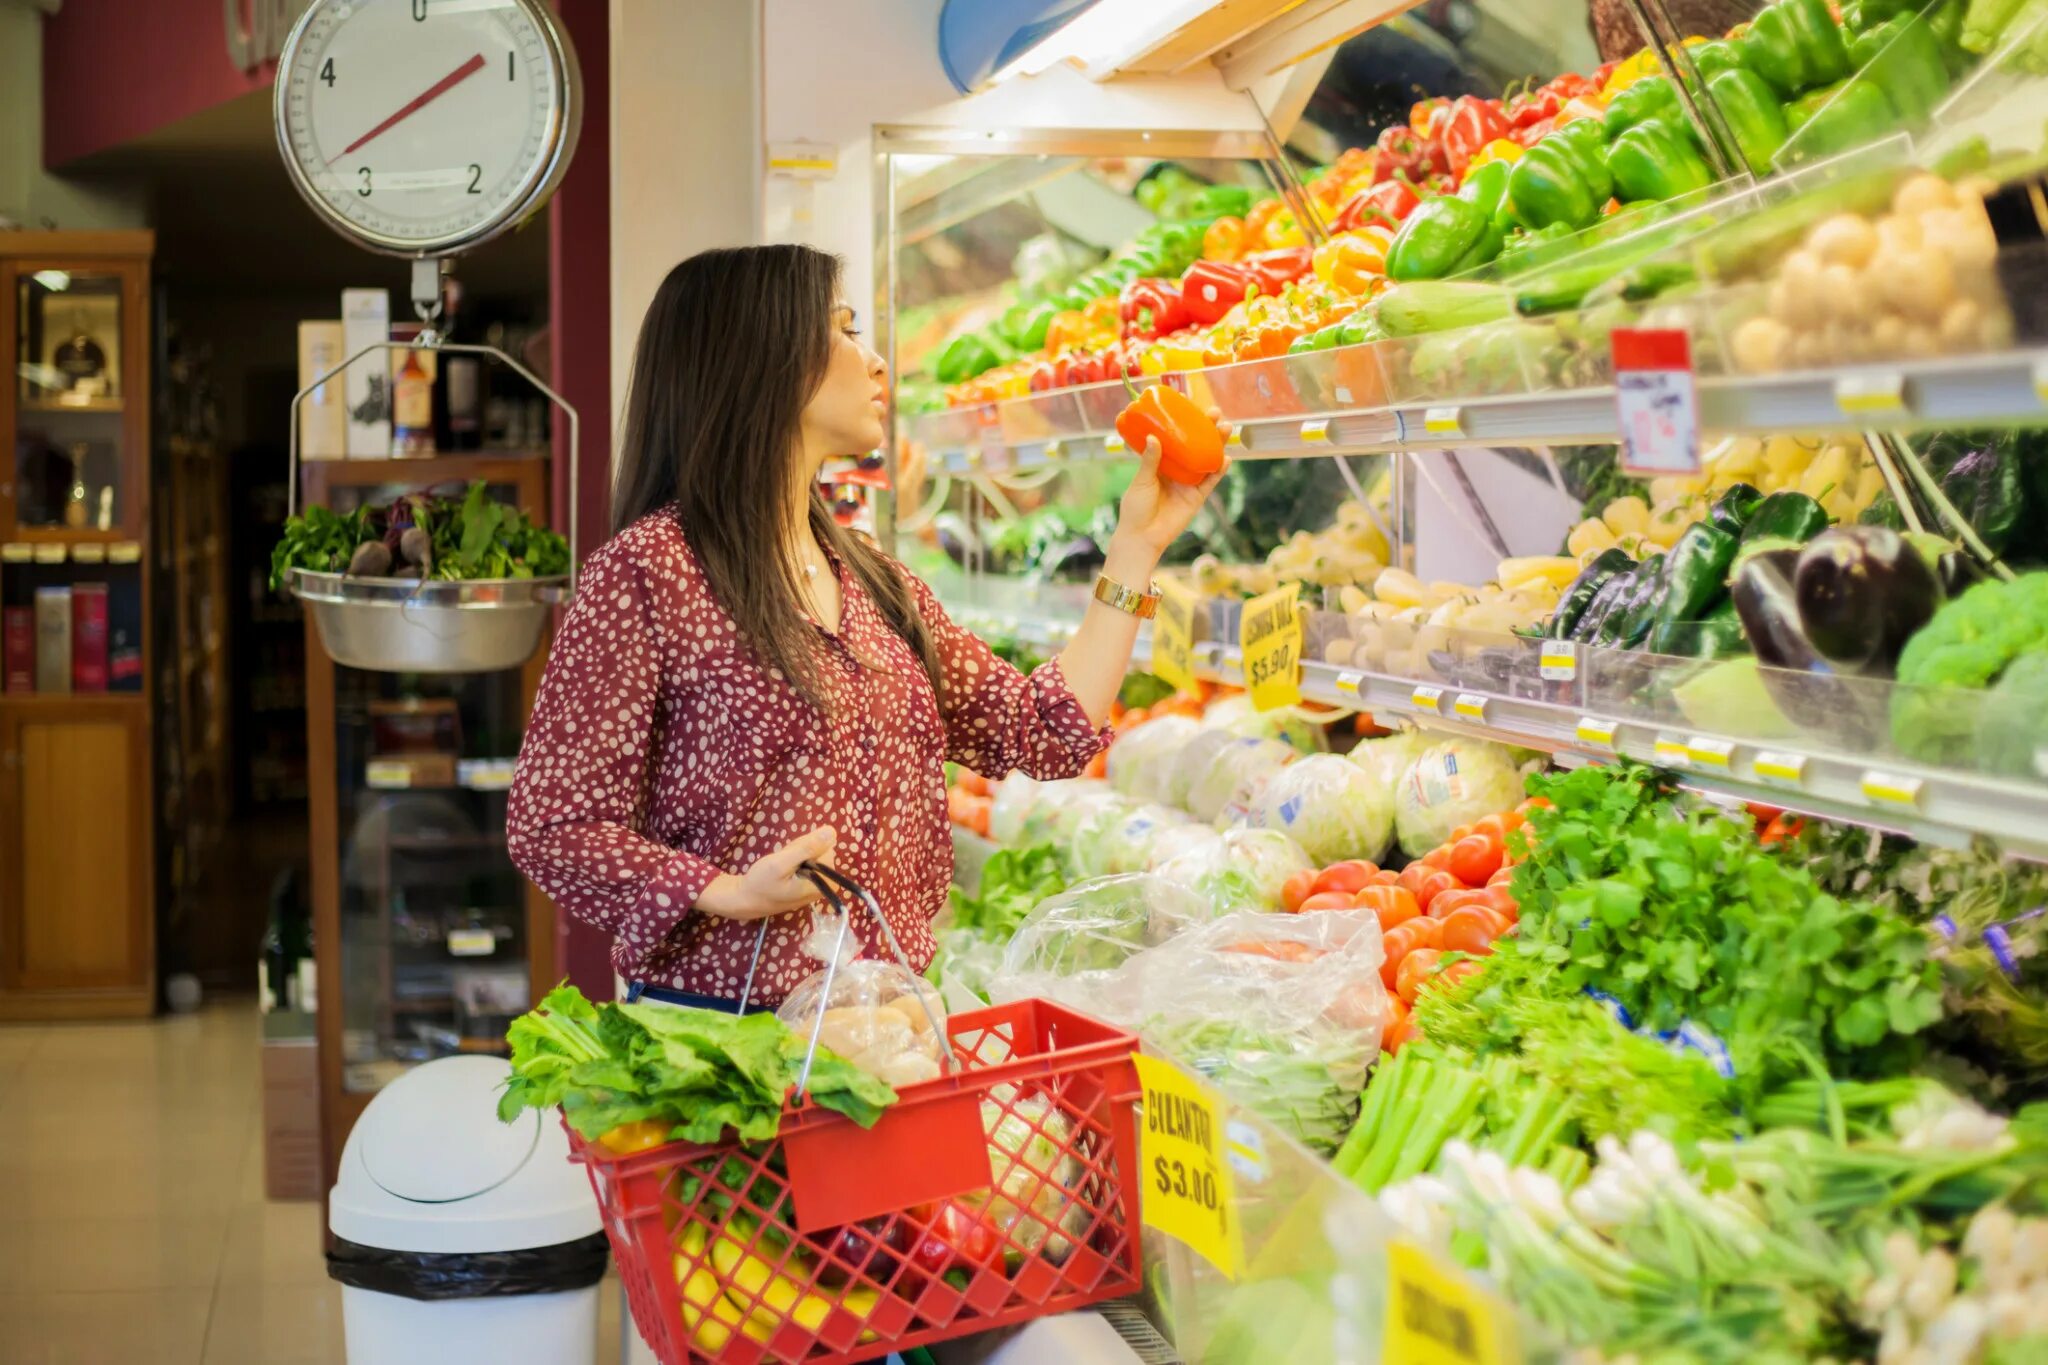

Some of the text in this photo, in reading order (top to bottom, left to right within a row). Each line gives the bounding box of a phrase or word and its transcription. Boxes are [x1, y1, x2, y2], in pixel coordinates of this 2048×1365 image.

[413, 0, 427, 22] 0
[320, 57, 336, 88] 4
[508, 51, 514, 82] 1
[357, 166, 373, 197] 3
[467, 164, 482, 195] 2
[1251, 644, 1289, 688] $5.90
[1154, 1153, 1217, 1211] $3.00
